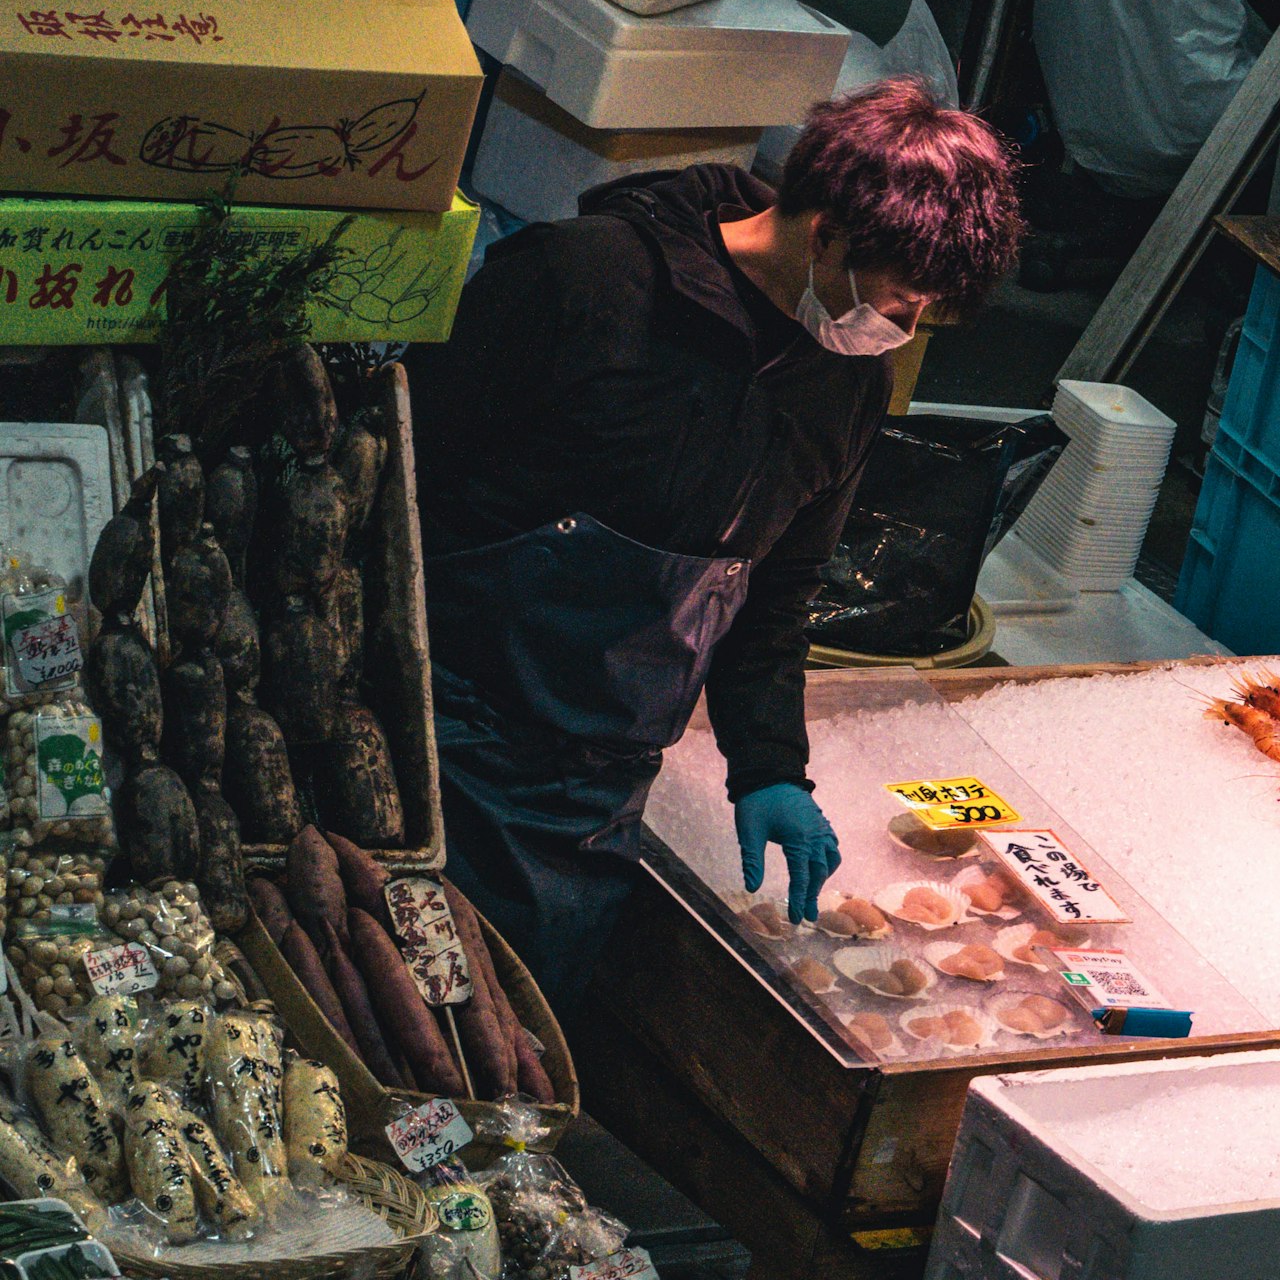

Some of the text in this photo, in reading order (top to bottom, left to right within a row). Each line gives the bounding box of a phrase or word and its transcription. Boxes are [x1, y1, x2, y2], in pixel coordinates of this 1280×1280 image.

[1031, 833, 1101, 894] この場で
[1081, 954, 1124, 966] PayPay
